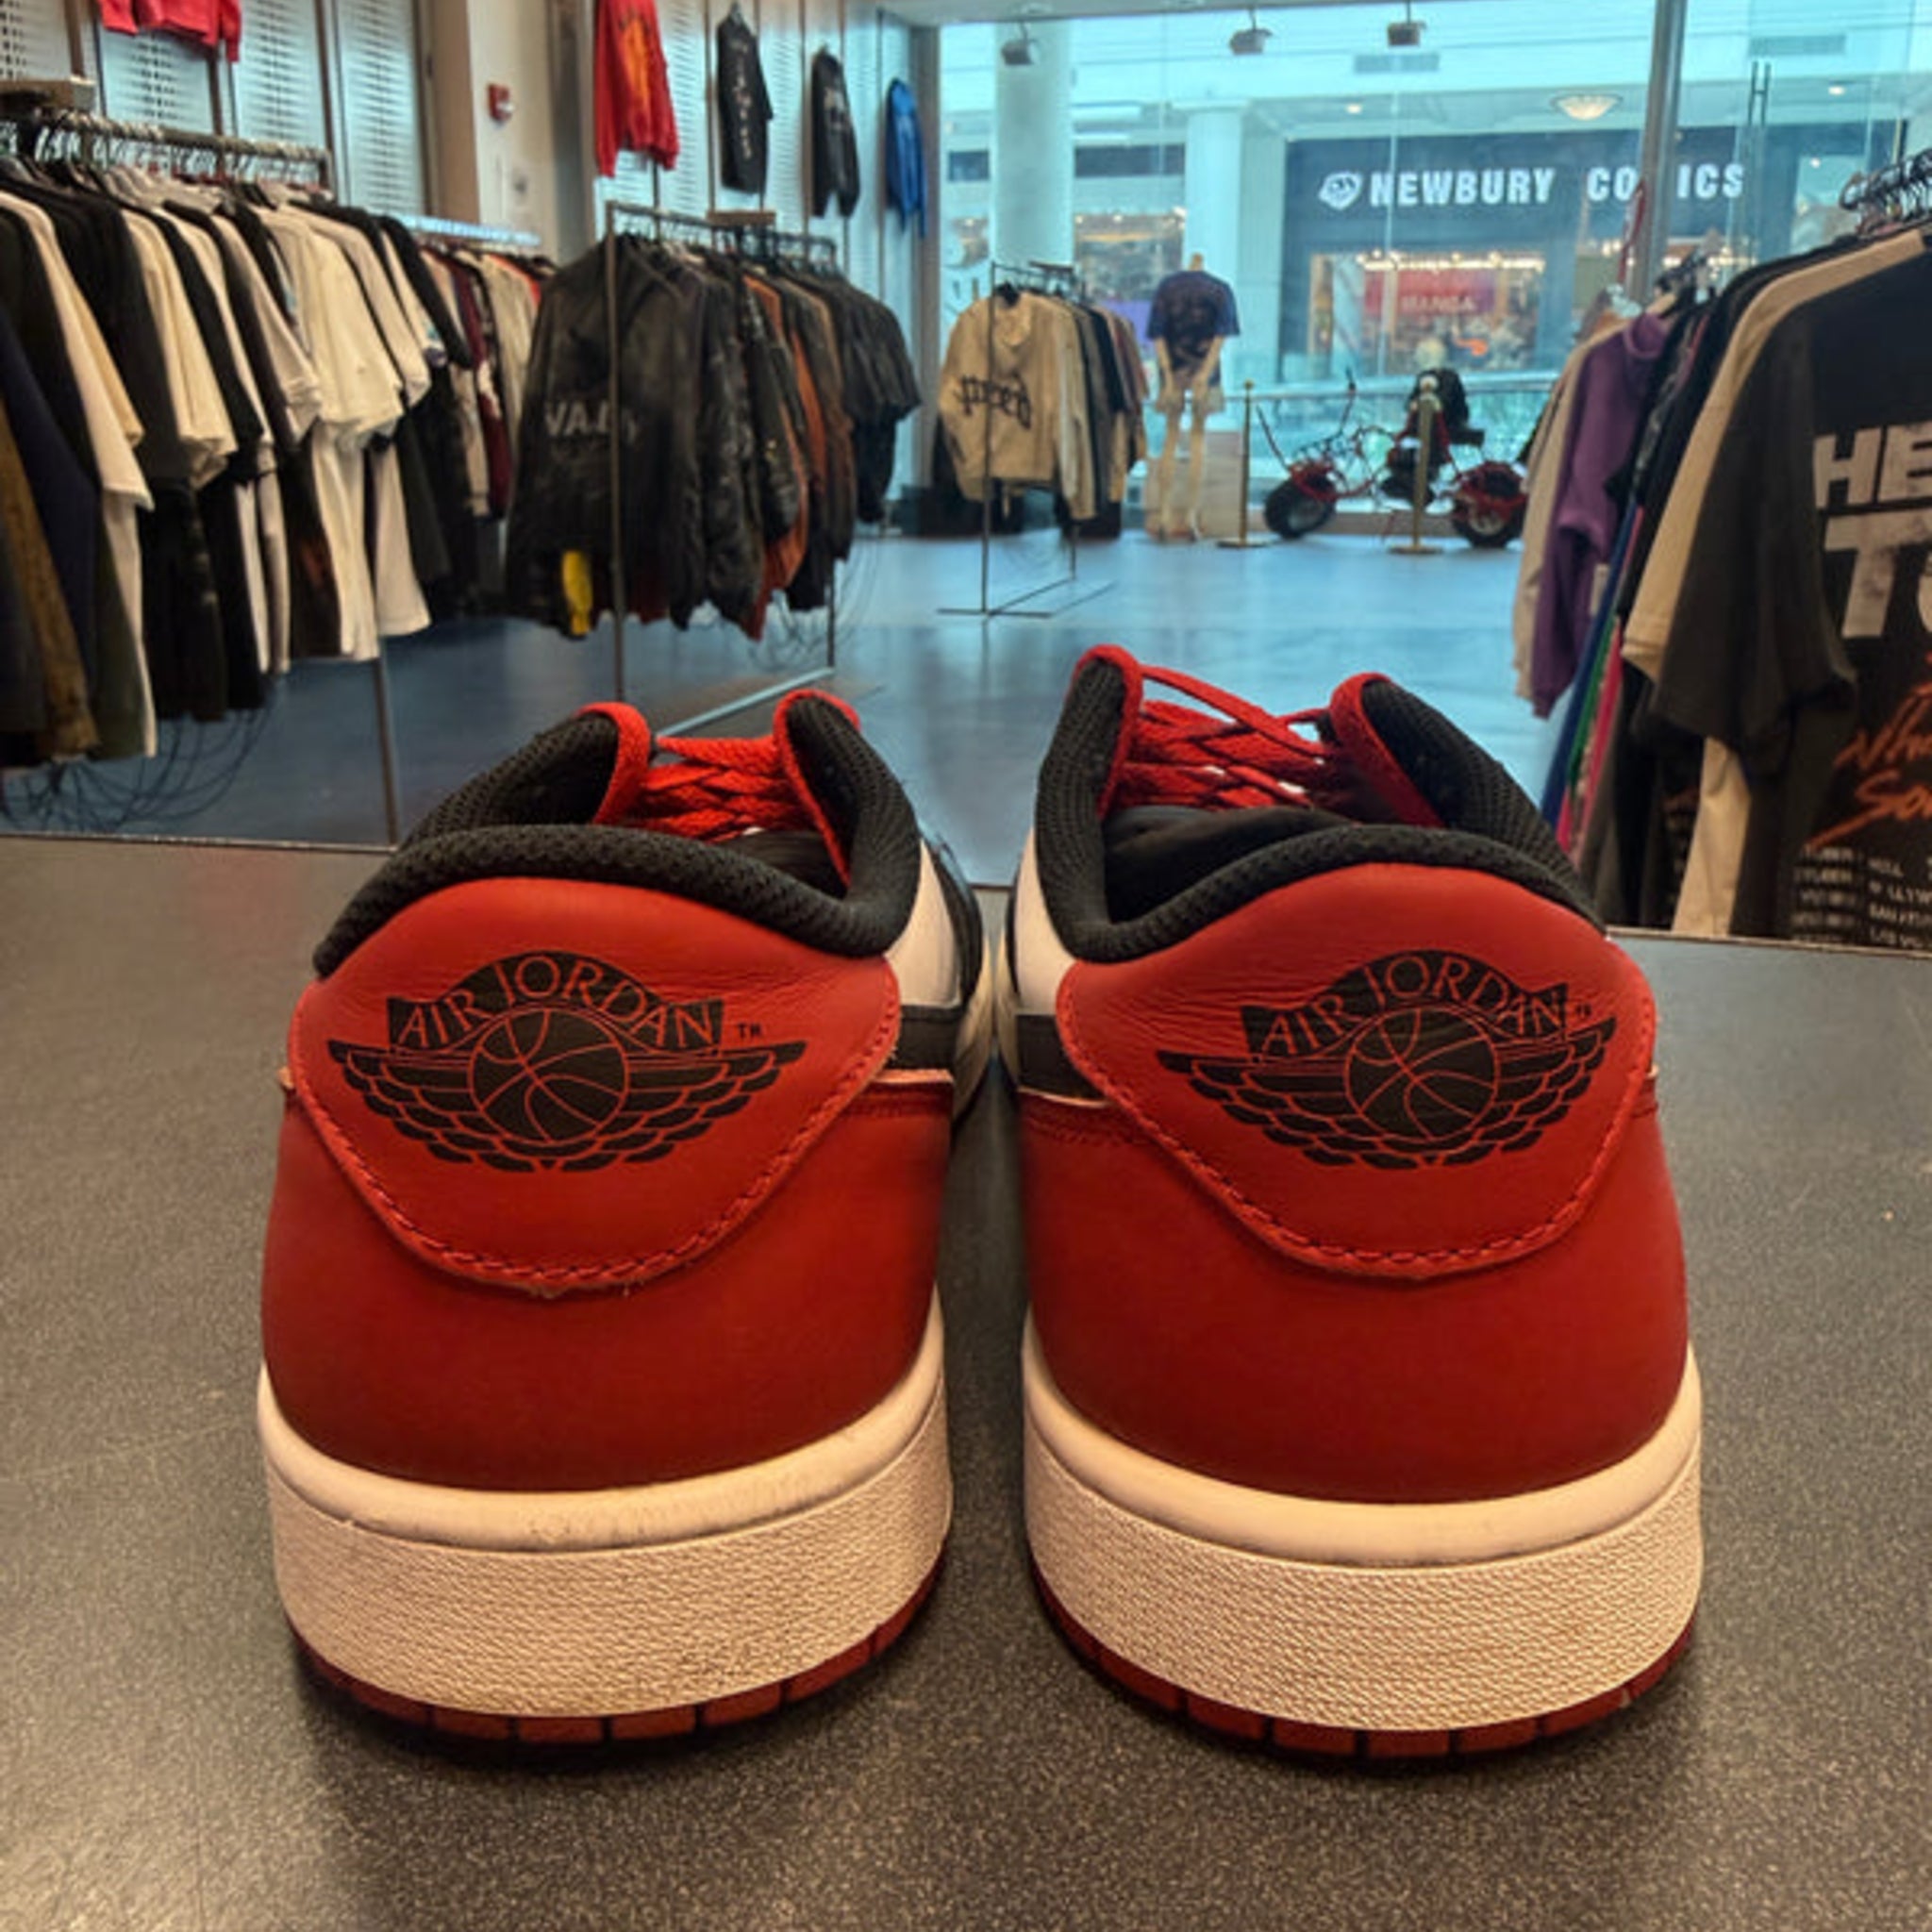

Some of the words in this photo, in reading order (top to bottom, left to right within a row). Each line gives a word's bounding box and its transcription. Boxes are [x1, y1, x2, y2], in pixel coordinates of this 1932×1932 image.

[1370, 168, 1557, 208] NEWBURY
[1587, 163, 1745, 202] COICS
[397, 993, 494, 1049] AIR
[493, 955, 719, 1049] JORDAN
[1261, 993, 1367, 1055] AIR
[1362, 955, 1562, 1036] JORDAN
